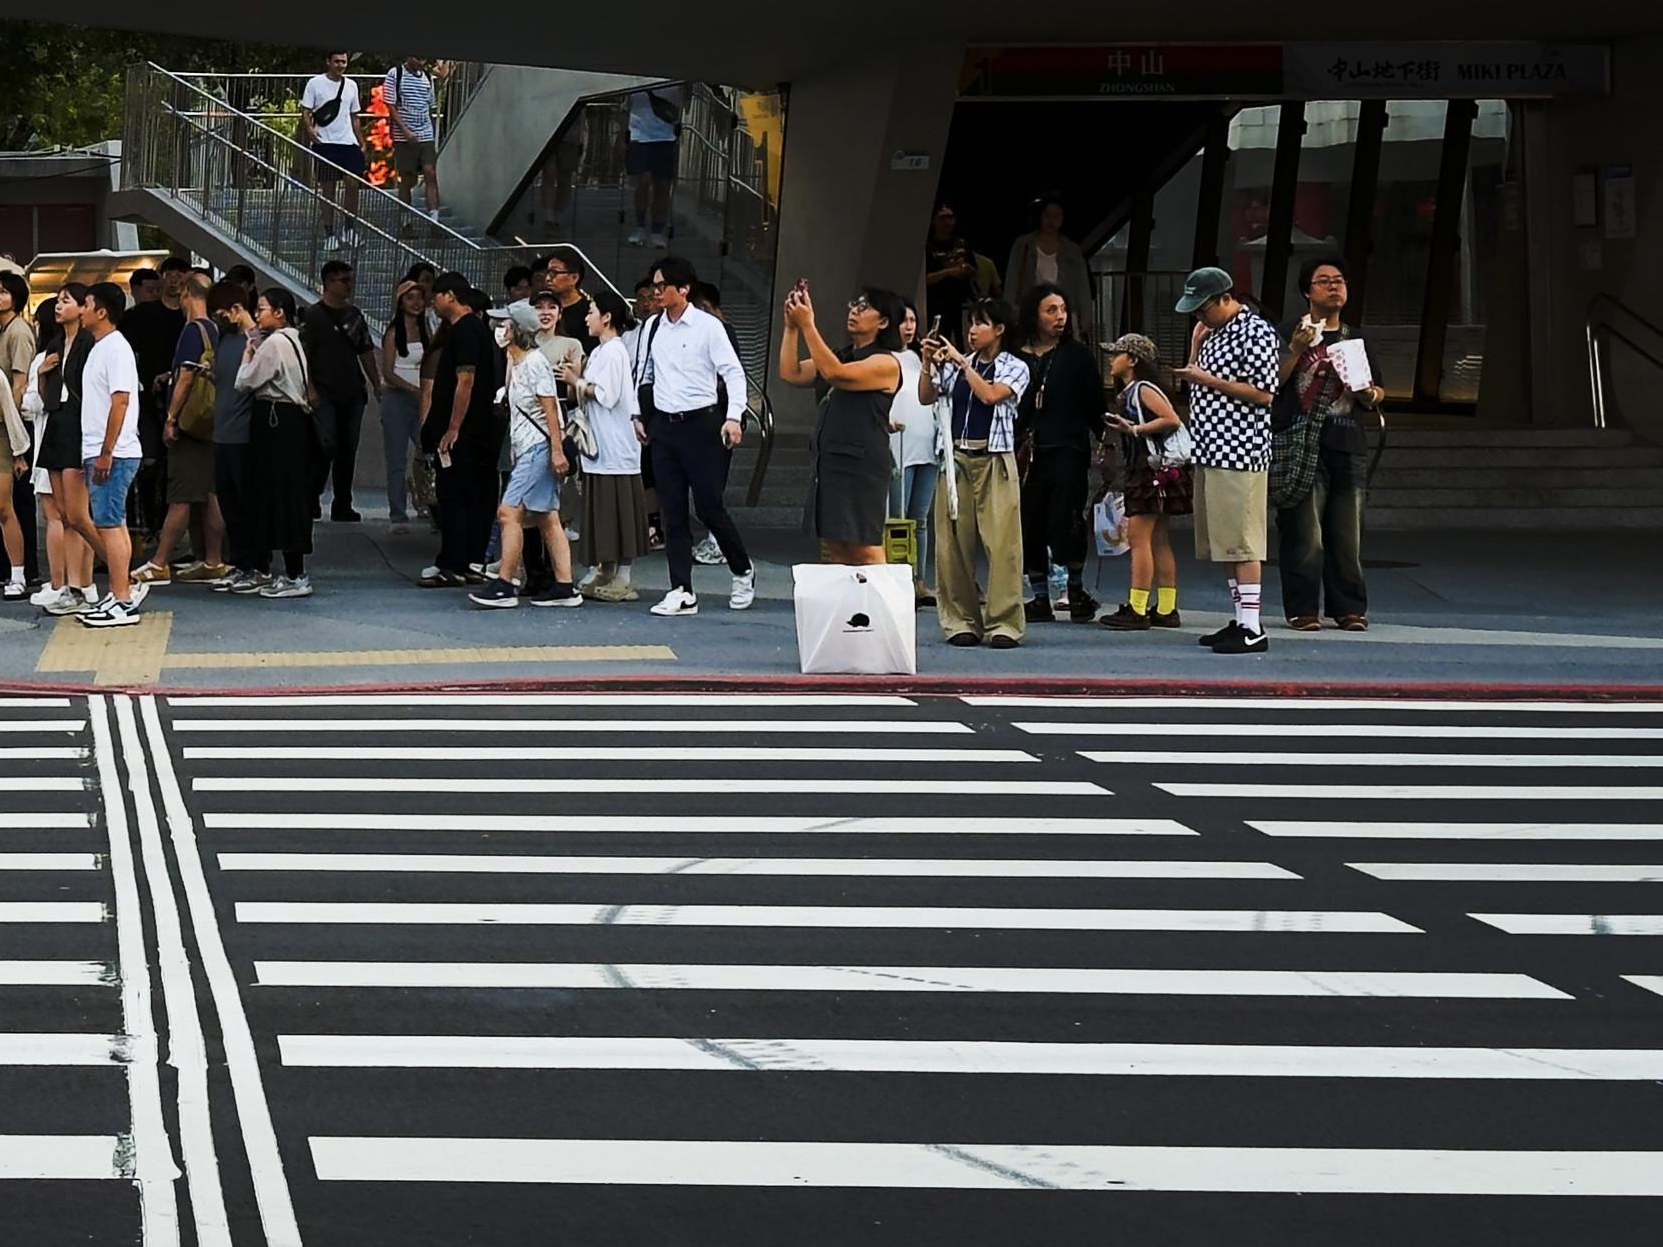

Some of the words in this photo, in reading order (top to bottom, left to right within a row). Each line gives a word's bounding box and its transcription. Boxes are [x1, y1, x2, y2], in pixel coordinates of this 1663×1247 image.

[1106, 49, 1165, 76] 中山
[1327, 58, 1440, 82] 中山地下街
[1457, 64, 1501, 80] MIKI
[1507, 63, 1567, 80] PLAZA
[1098, 82, 1176, 93] ZHONGSHAN
